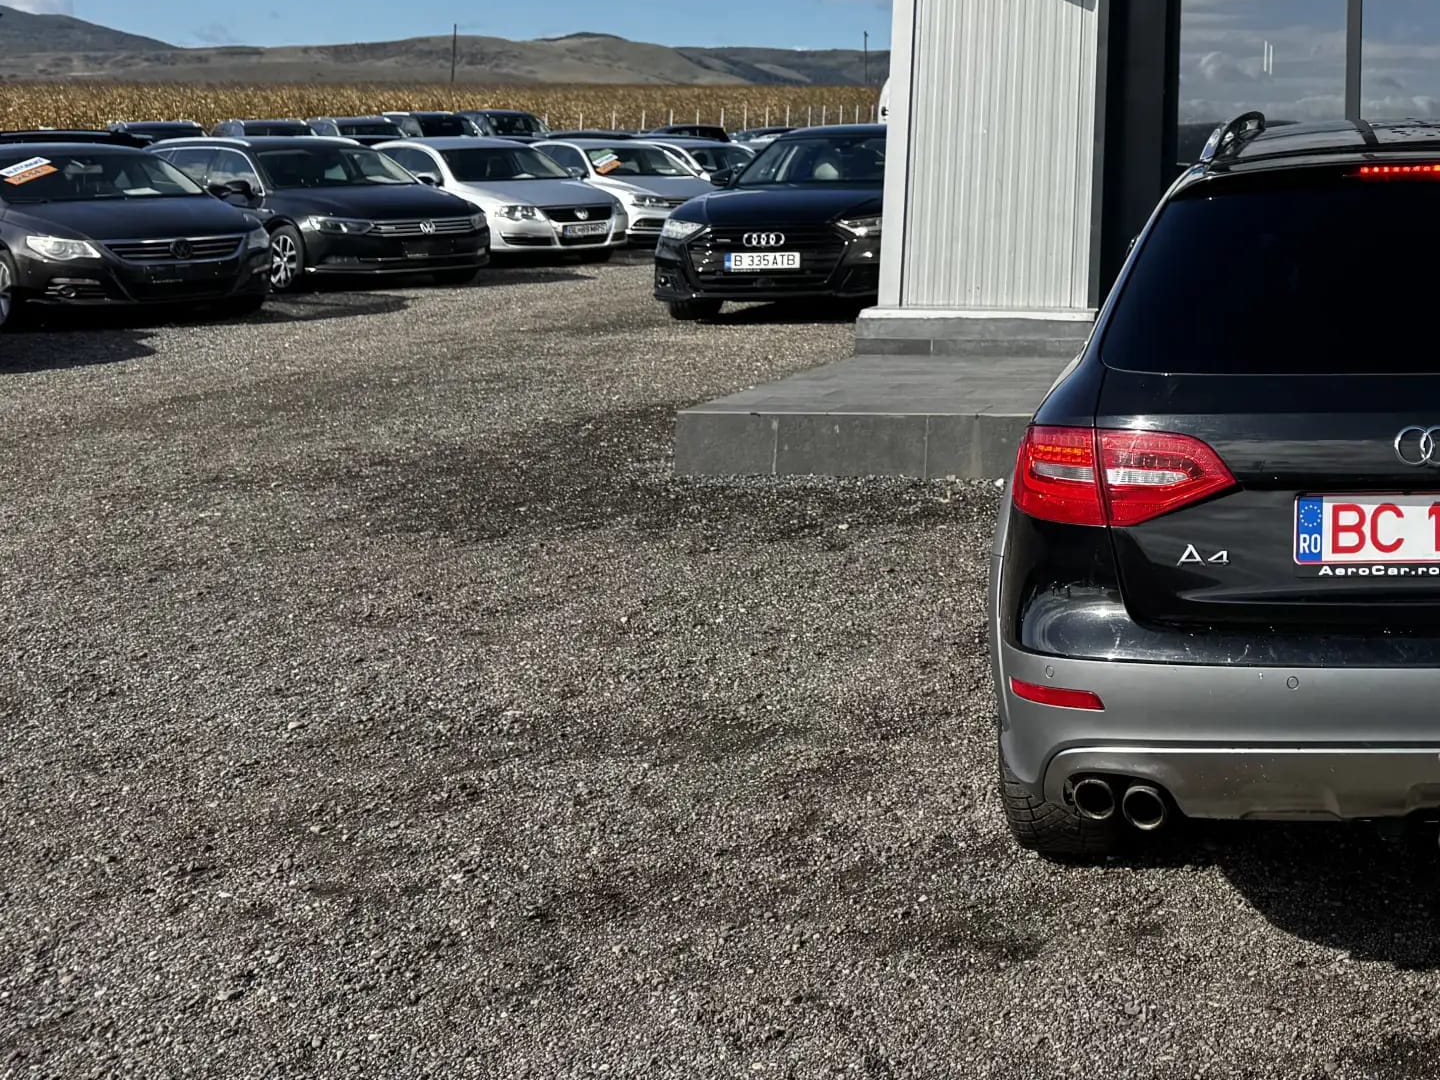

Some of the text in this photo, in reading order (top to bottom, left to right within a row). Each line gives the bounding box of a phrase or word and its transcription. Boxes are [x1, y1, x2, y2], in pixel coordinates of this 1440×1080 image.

[734, 254, 796, 267] B 335 ATB
[1331, 503, 1405, 554] BC
[1299, 533, 1321, 554] RO
[1318, 565, 1440, 576] AeroCar.ro
